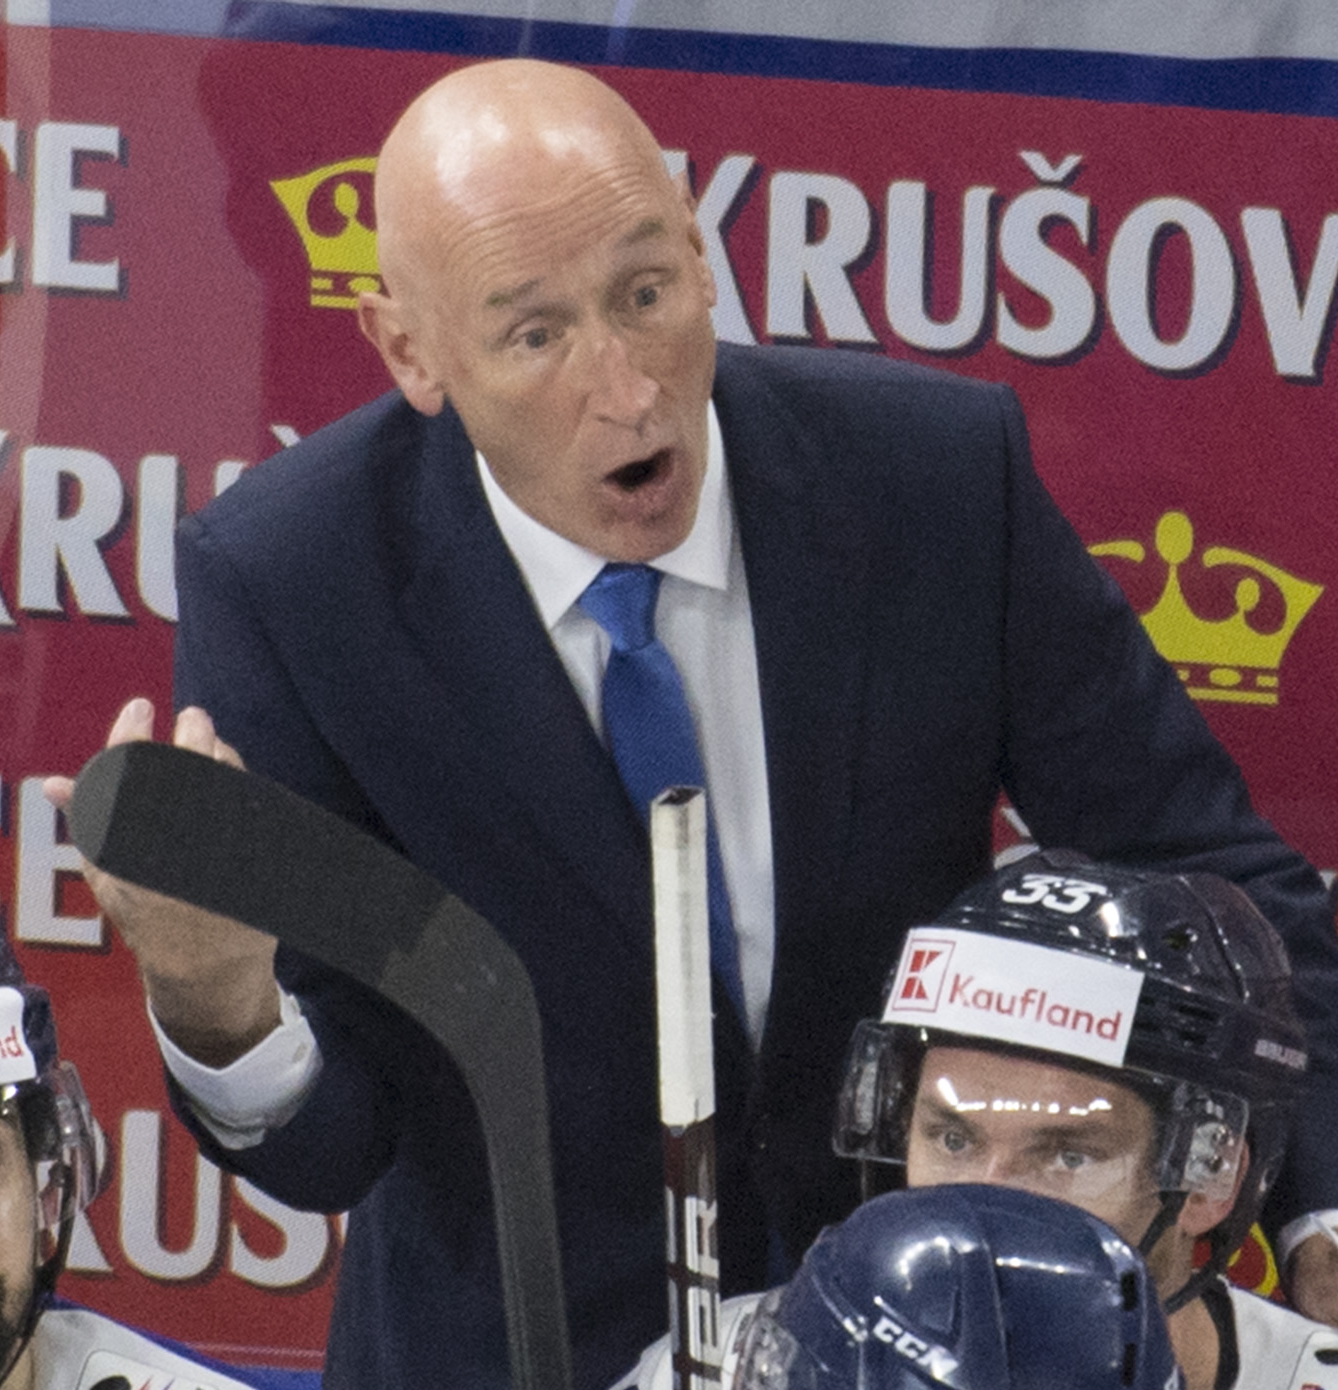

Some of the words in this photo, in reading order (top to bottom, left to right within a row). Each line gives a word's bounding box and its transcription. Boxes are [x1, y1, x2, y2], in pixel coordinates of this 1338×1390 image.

[1004, 872, 1106, 914] 33
[949, 973, 1123, 1043] Kaufland
[873, 1315, 959, 1379] CCM
